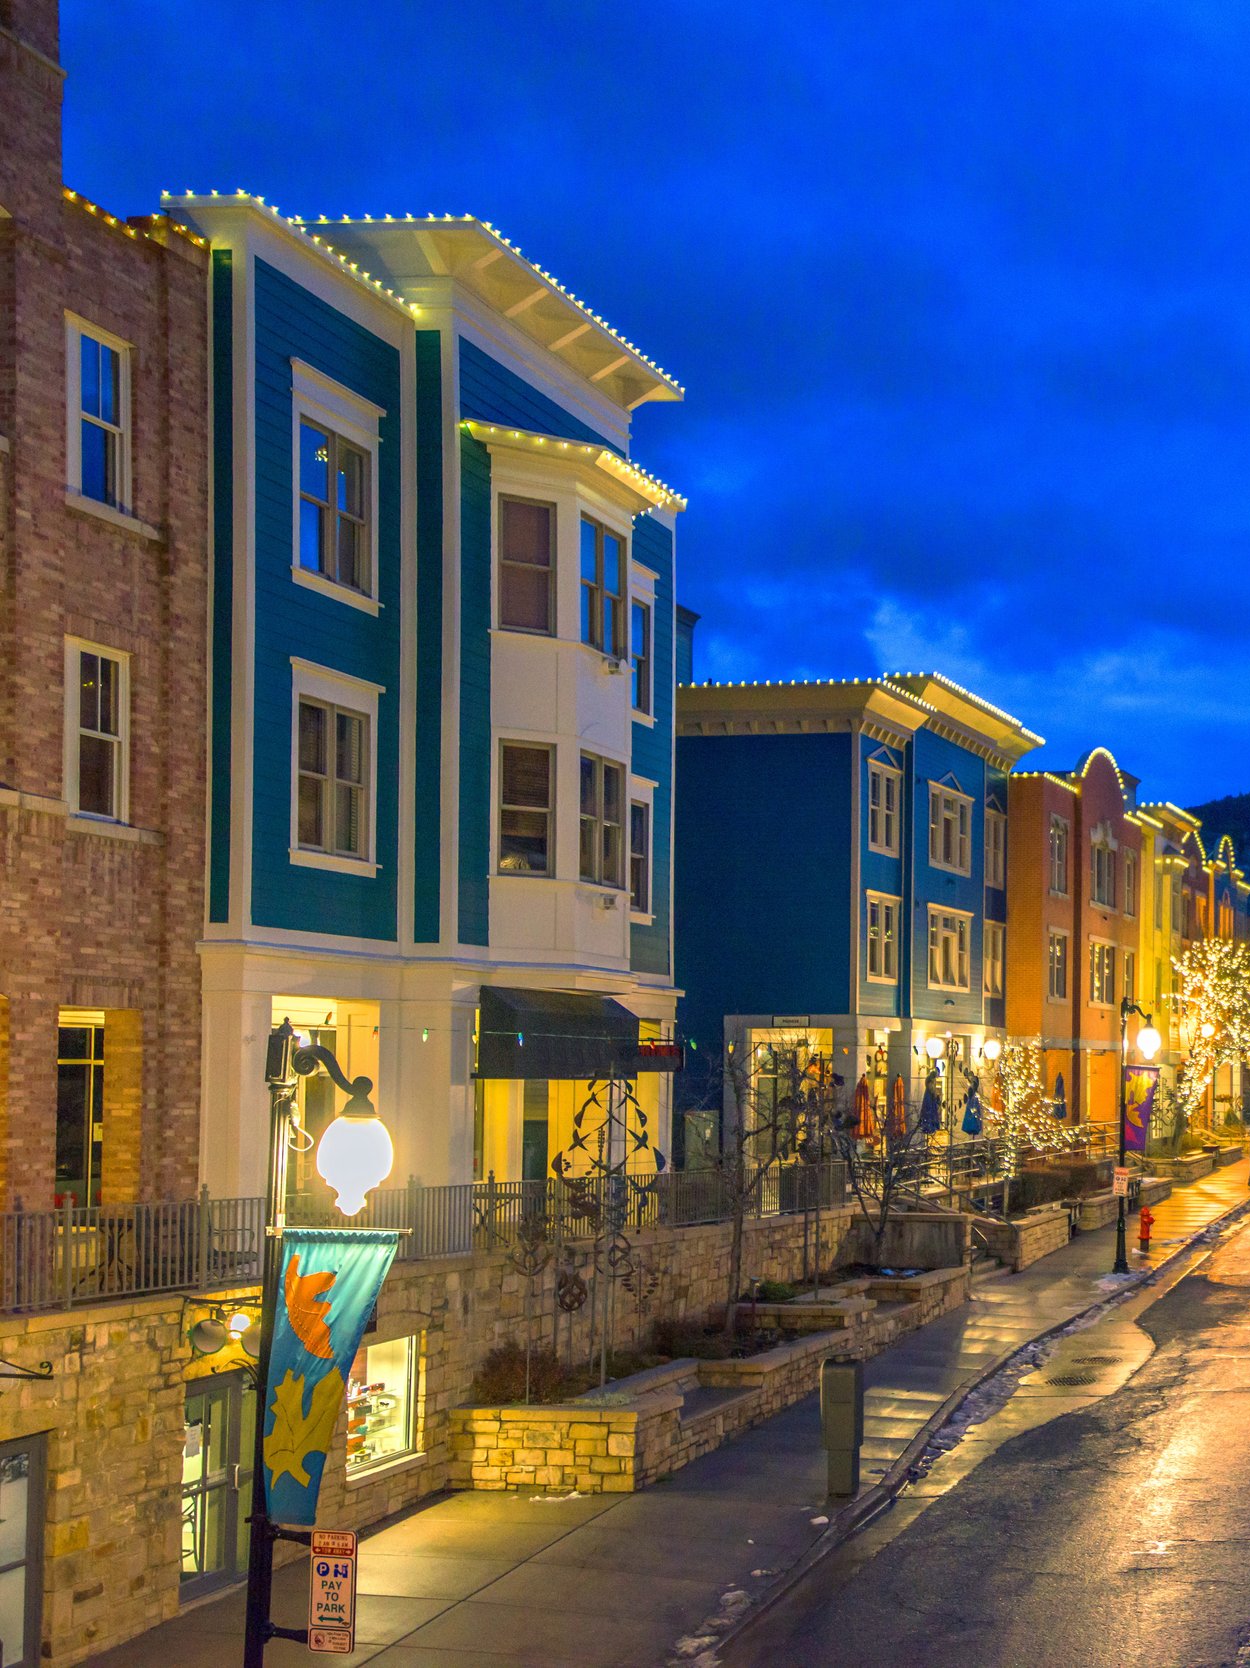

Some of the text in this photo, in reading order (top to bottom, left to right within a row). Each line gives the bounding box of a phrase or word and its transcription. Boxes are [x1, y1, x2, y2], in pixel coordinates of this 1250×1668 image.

[321, 1580, 343, 1590] PAY
[325, 1591, 339, 1602] TO
[316, 1602, 345, 1614] PARK
